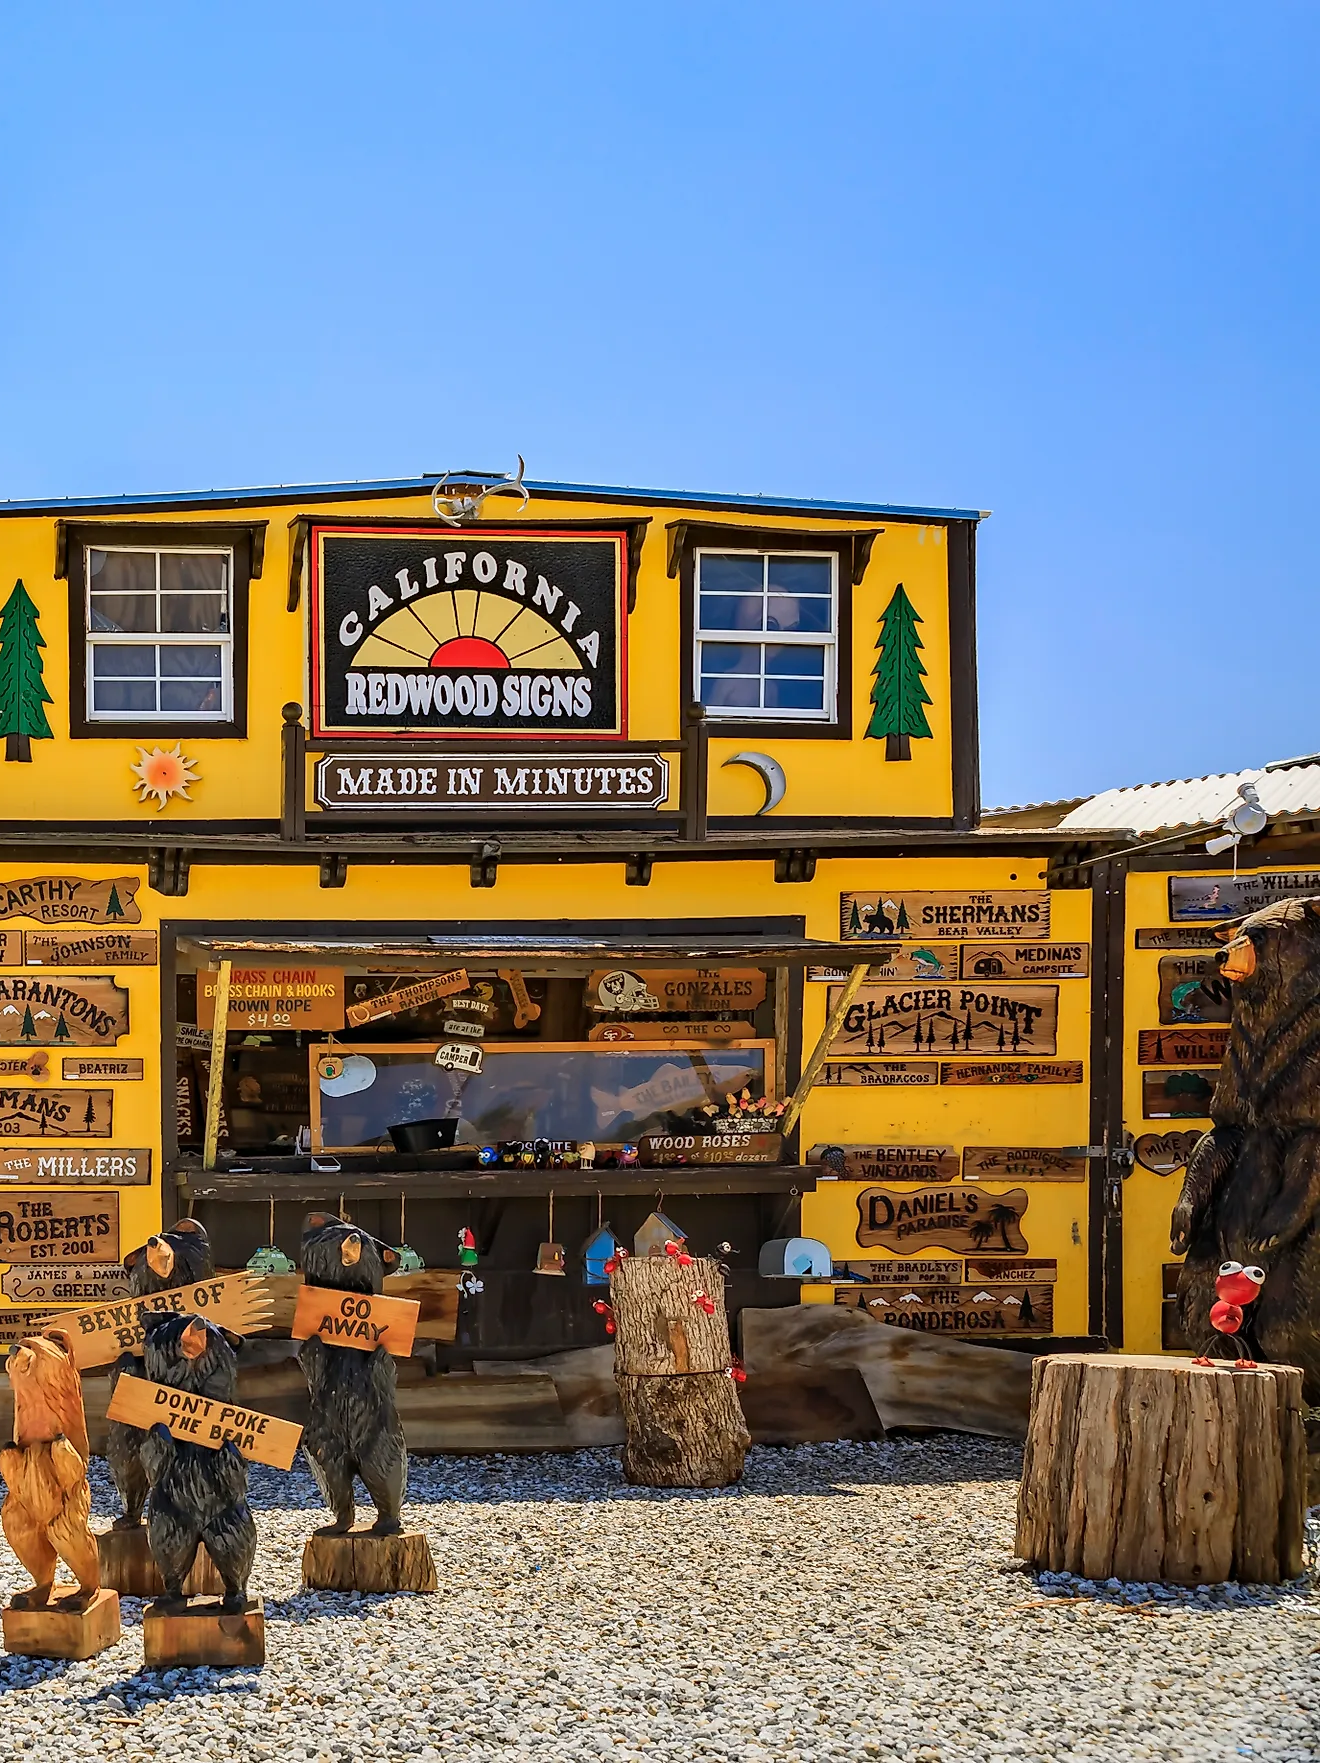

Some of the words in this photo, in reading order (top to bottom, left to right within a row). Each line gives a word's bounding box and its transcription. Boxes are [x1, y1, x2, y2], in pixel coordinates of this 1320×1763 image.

[339, 552, 599, 668] CALIFORNIA
[345, 673, 498, 716] REDWOOD
[502, 675, 592, 717] SIGNS
[337, 767, 437, 796] MADE
[447, 768, 483, 796] IN
[493, 766, 654, 796] MINUTES
[1234, 880, 1258, 891] THE
[969, 895, 992, 904] THE
[1244, 896, 1270, 905] SHUT
[41, 904, 100, 921] RESORT
[922, 904, 1040, 924] SHERMANS
[937, 927, 968, 936] BEAR
[976, 926, 1024, 936] VALLEY
[33, 935, 58, 946] THE
[1149, 933, 1172, 946] THE
[50, 935, 132, 962] JOHNSON
[1015, 947, 1082, 962] MEDINA'S
[105, 951, 150, 962] FAMILY
[1022, 964, 1074, 974] CAMPSITE
[1173, 960, 1206, 975] THE
[273, 971, 316, 984] CHAIN
[245, 985, 281, 997] CHAIN
[286, 985, 294, 997] &
[297, 984, 335, 997] HOOKS
[371, 995, 394, 1008] THE
[396, 971, 462, 999] THOMPSONS
[664, 981, 753, 996] GONZALES
[276, 1000, 311, 1012] ROPE
[399, 990, 439, 1010] RANCH
[452, 1000, 469, 1009] BEST
[470, 1000, 489, 1013] DAYS
[843, 989, 952, 1032] GLACIER
[959, 990, 1042, 1034] POINT
[181, 1027, 204, 1038] SMILE
[685, 1025, 708, 1033] THE
[440, 1051, 469, 1064] CAMPER
[79, 1063, 129, 1074] BEATRIZ
[884, 1064, 907, 1072] THE
[956, 1063, 1021, 1079] HERNANDEZ
[1027, 1064, 1072, 1078] FAMILY
[649, 1136, 696, 1150] WOOD
[702, 1135, 751, 1148] ROSES
[1145, 1139, 1180, 1157] MIKE
[736, 1152, 768, 1161] dozen
[853, 1151, 872, 1160] THE
[876, 1148, 947, 1162] BENTLEY
[976, 1156, 1001, 1172] THE
[1006, 1150, 1073, 1172] RODRIGUEZ
[4, 1158, 32, 1171] THE
[37, 1156, 137, 1177] MILLERS
[17, 1201, 53, 1218] THE
[868, 1192, 978, 1230] DANIEL'S
[896, 1215, 970, 1241] PARADISE
[30, 1244, 58, 1259] EST.
[62, 1240, 95, 1255] 2001
[27, 1270, 67, 1280] JAMES
[76, 1271, 83, 1280] &
[93, 1270, 130, 1280] DAWN
[870, 1263, 892, 1272] THE
[897, 1263, 958, 1272] BRADLEYS
[52, 1284, 107, 1297] GREEN
[193, 1281, 225, 1308] OF
[931, 1291, 959, 1305] THE
[340, 1297, 372, 1319] GO
[883, 1311, 1005, 1330] PONDEROSA
[318, 1316, 389, 1342] AWAY
[154, 1388, 215, 1417] DON'T
[220, 1408, 270, 1434] POKE
[169, 1412, 202, 1434] THE
[209, 1424, 256, 1451] BEAR
